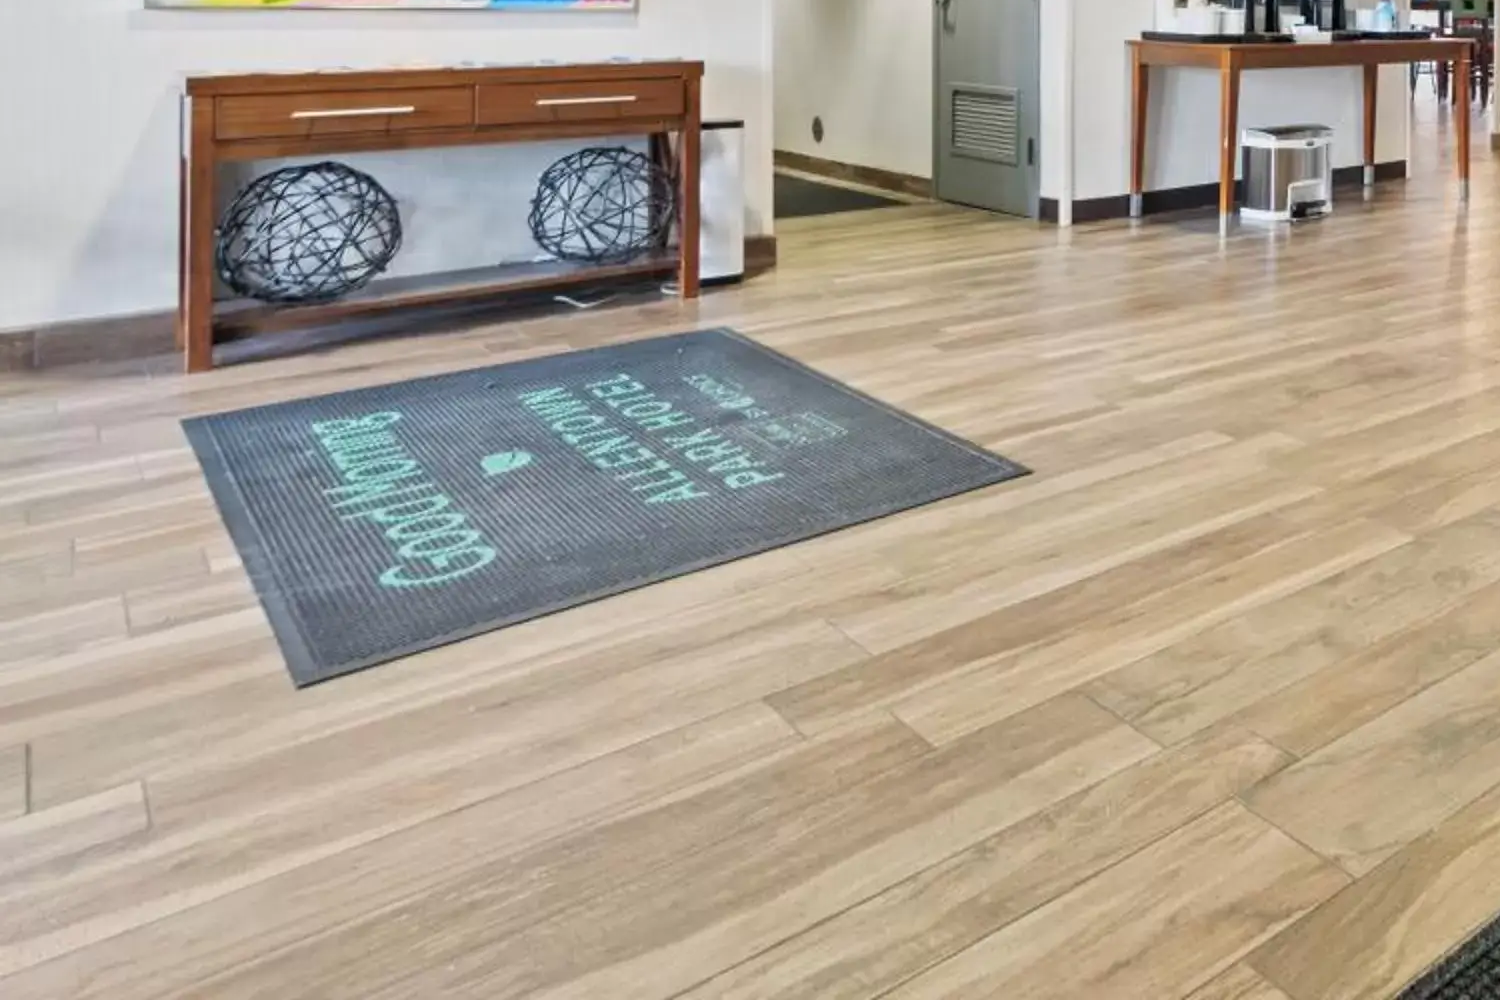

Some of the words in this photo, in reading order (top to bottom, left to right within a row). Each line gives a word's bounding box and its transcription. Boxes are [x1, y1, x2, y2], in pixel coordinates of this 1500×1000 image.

[585, 373, 695, 431] HOTEL
[517, 386, 709, 504] ALLENTOWN
[663, 427, 785, 489] PARK
